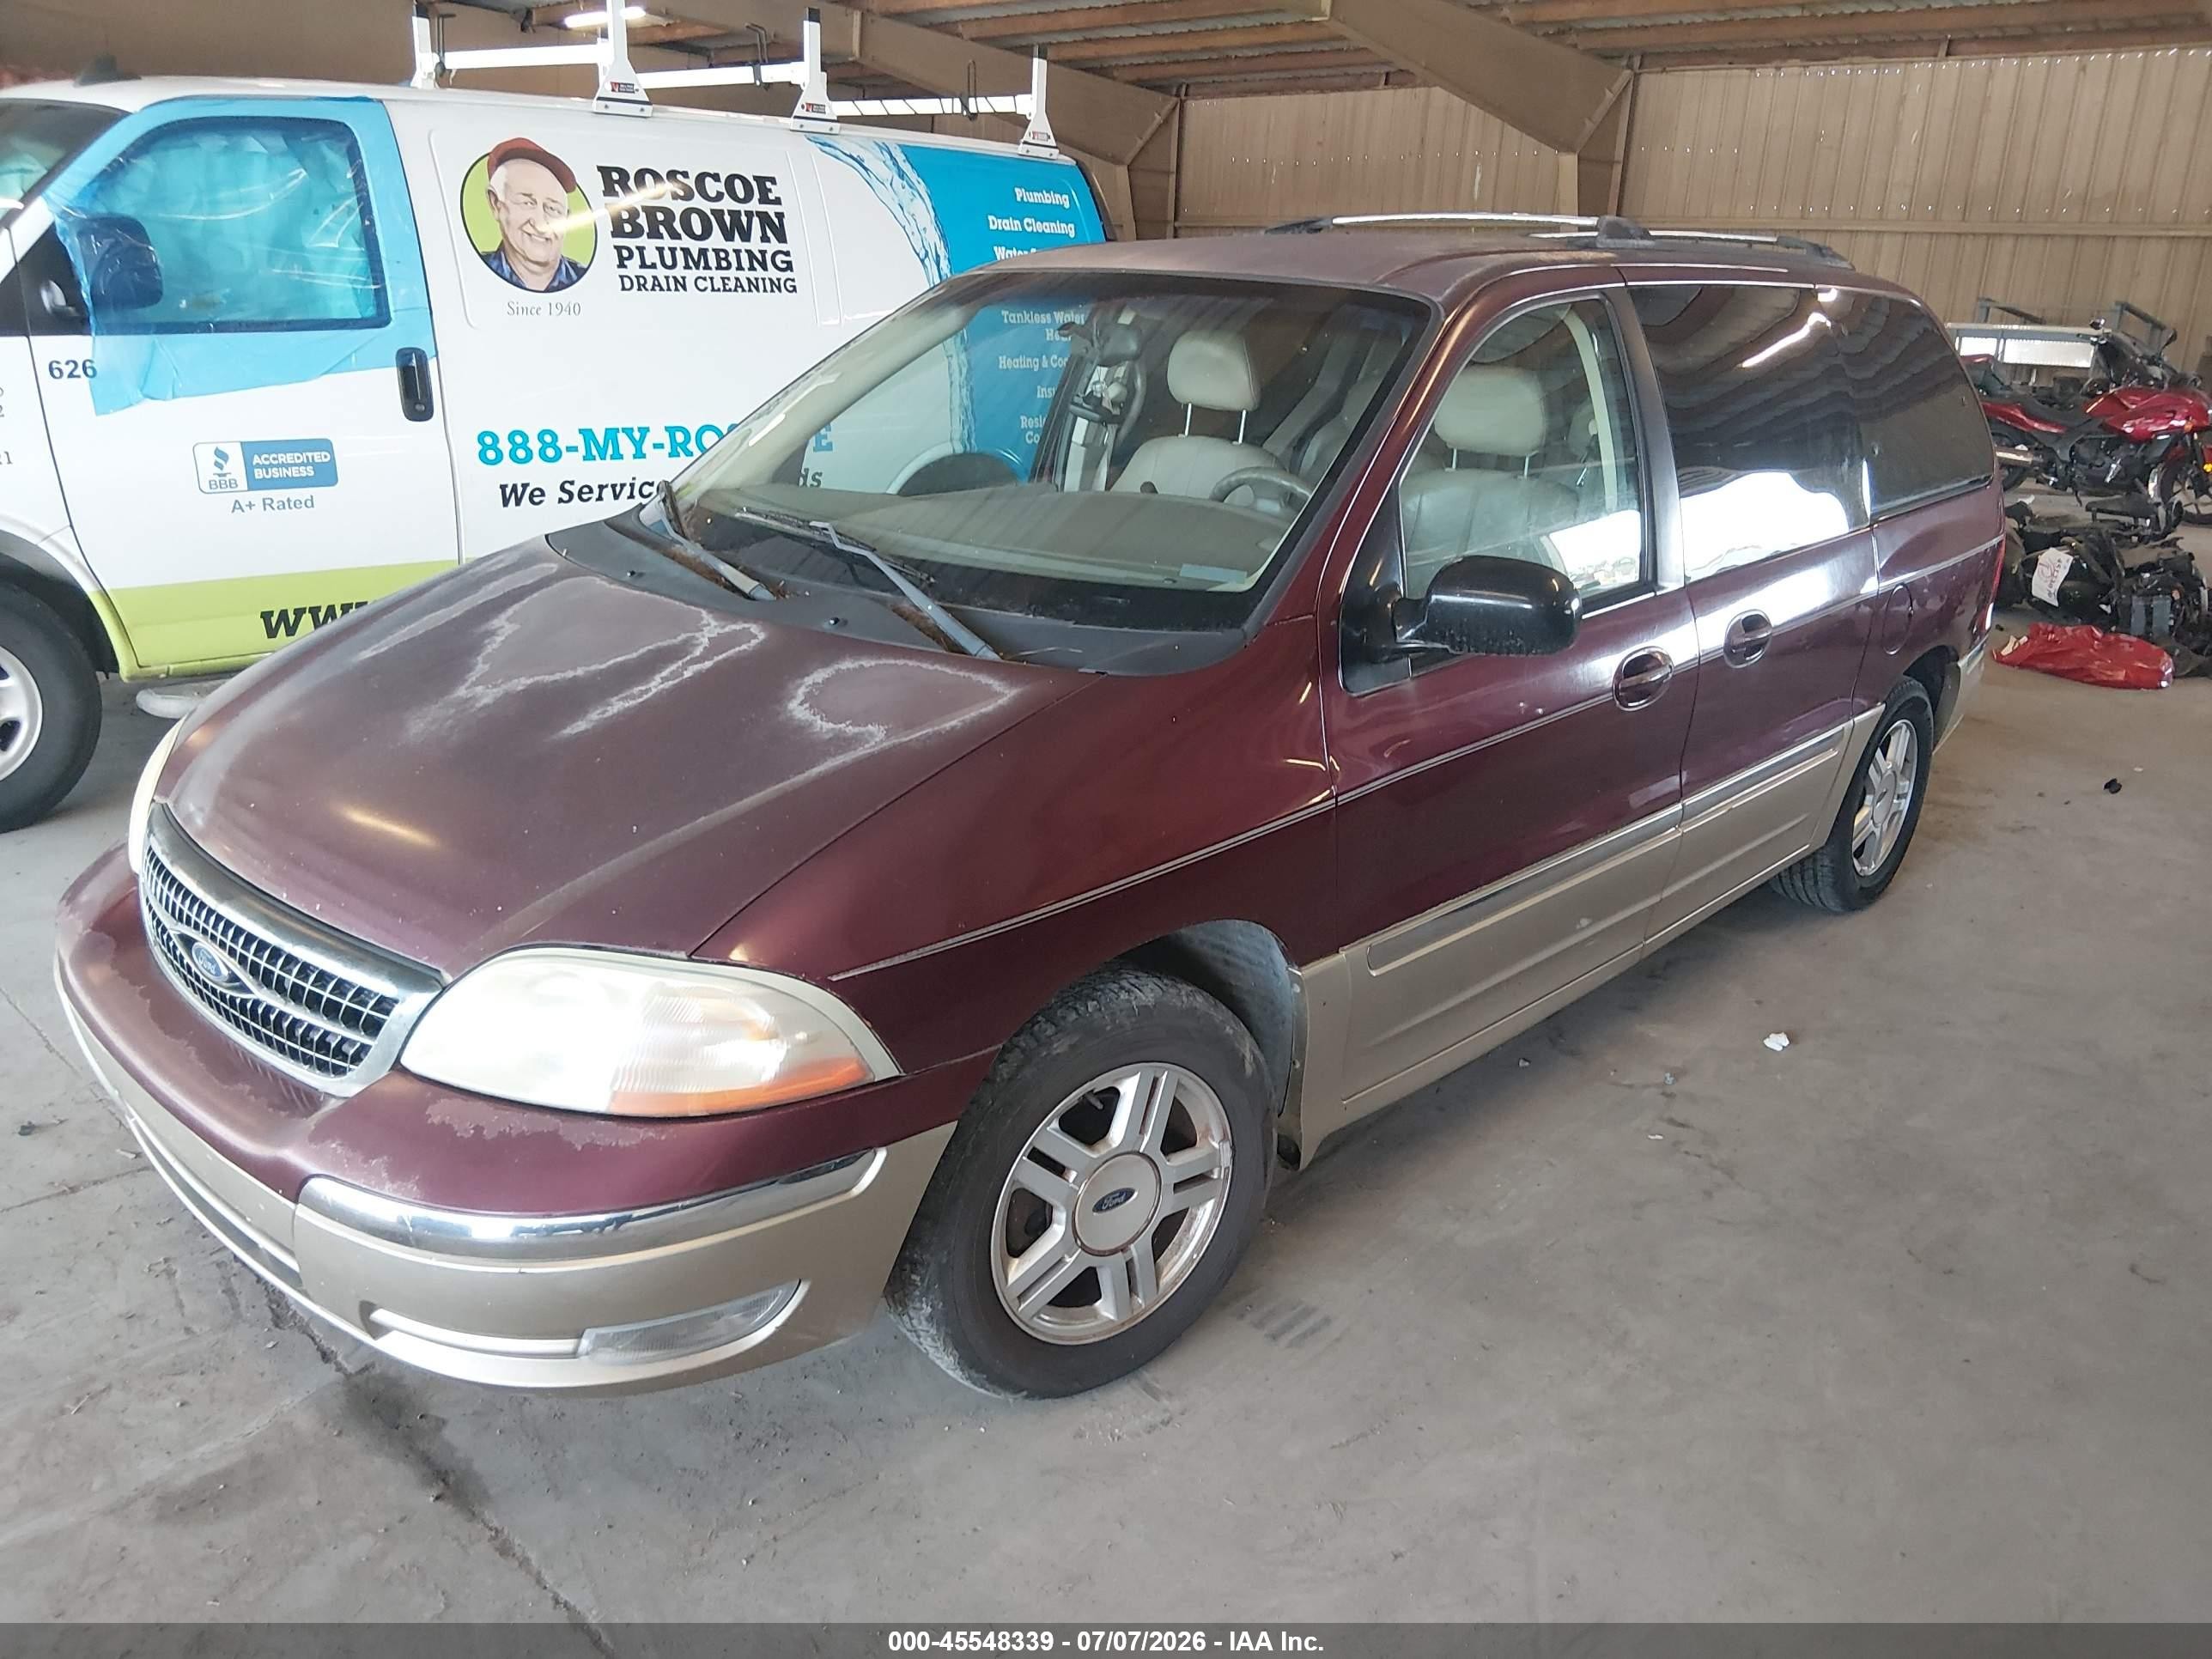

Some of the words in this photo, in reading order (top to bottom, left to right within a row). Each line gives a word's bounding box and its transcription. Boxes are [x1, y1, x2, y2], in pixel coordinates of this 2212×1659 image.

[597, 165, 782, 205] ROSCOE
[1014, 187, 1070, 209] Plumbing
[605, 203, 787, 244] BROWN
[988, 215, 1023, 232] Drain
[1023, 217, 1075, 239] Cleaning
[613, 245, 793, 272] PLUMBING
[618, 274, 687, 292] DRAIN
[694, 276, 797, 294] CLEANING
[507, 301, 542, 317] Since
[549, 301, 581, 317] 1940
[1001, 309, 1052, 325] Tankless
[1053, 310, 1085, 325] Water
[48, 359, 97, 380] 626
[999, 354, 1039, 372] Heating
[1042, 356, 1048, 369] &
[252, 452, 331, 466] ACCREDITED
[254, 466, 315, 480] BUSINESS
[209, 478, 239, 490] BBB
[499, 482, 546, 508] We
[557, 477, 656, 504] Servic
[231, 499, 256, 514] A+
[262, 495, 315, 512] Rated
[1101, 1192, 1127, 1210] Ford
